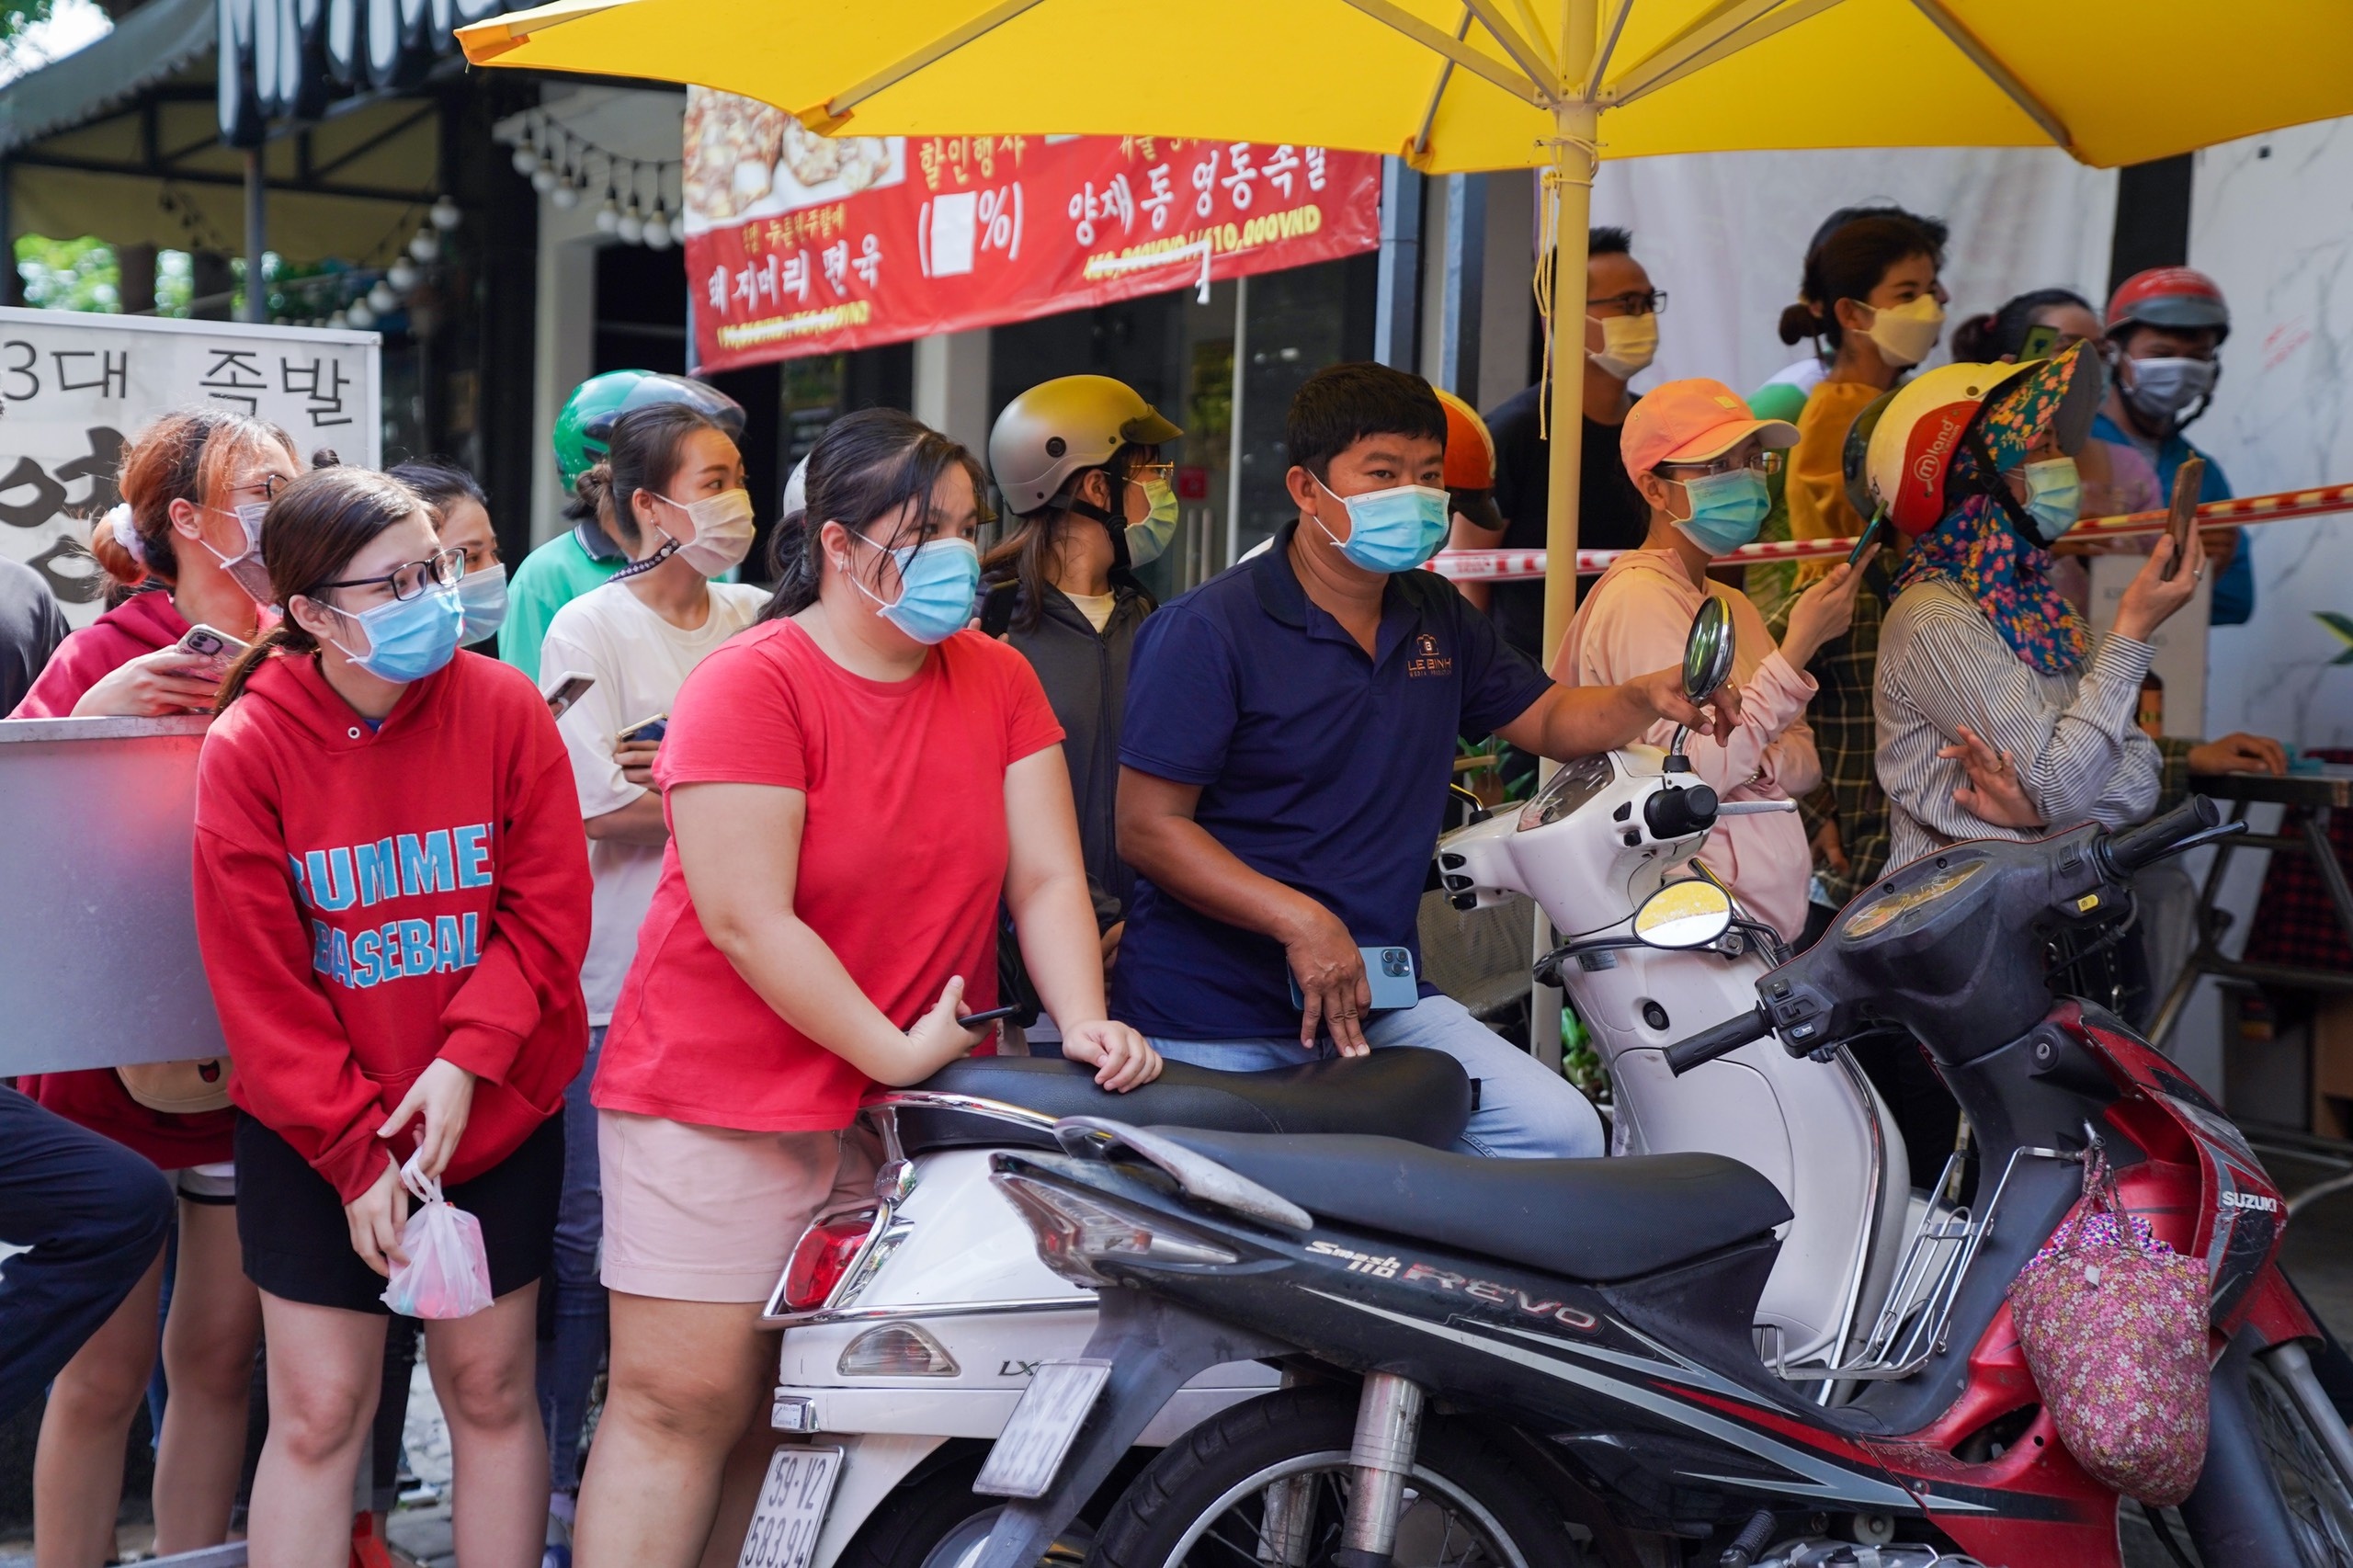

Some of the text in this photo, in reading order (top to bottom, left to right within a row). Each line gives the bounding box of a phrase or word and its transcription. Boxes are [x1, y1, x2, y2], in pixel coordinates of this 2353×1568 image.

[3, 340, 353, 427] 3대 족발
[288, 822, 494, 912] UMME
[2222, 1191, 2278, 1213] SUZUKI
[1305, 1240, 1401, 1269] Smash
